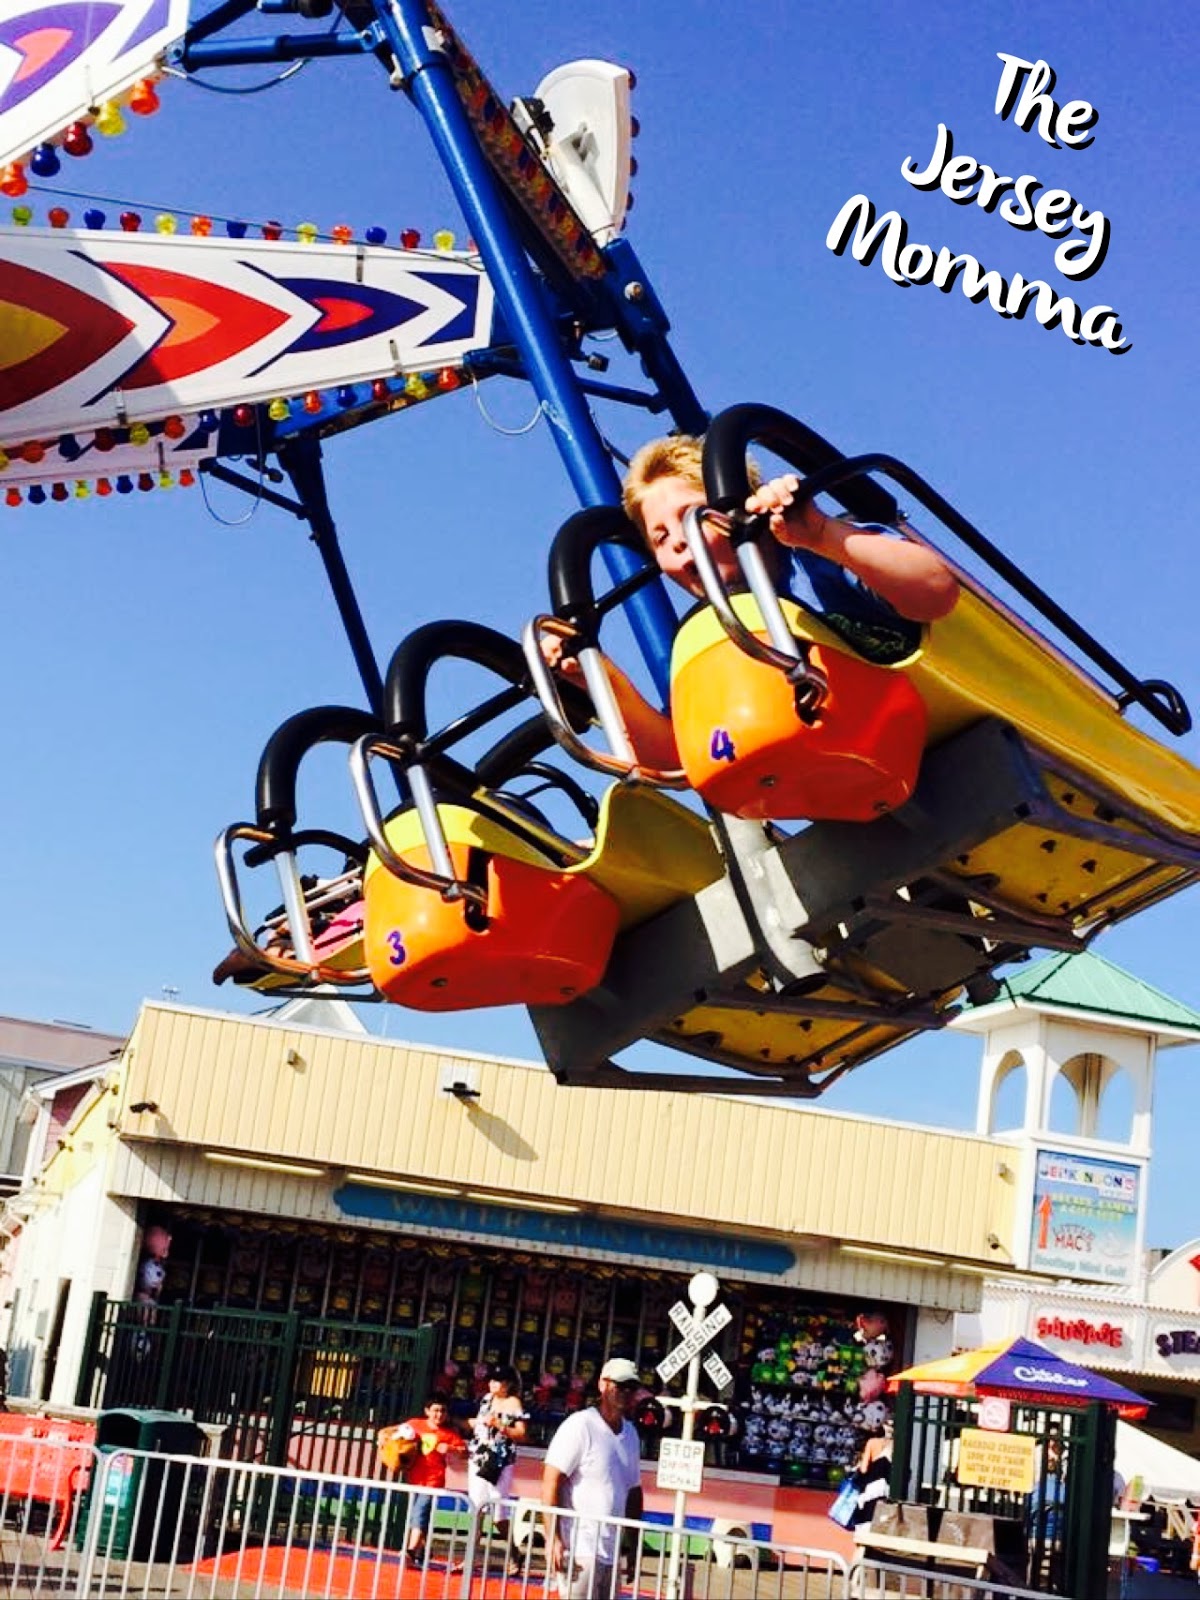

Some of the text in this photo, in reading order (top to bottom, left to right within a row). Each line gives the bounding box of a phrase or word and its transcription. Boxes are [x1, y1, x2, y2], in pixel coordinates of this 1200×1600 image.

[711, 729, 735, 764] 4
[387, 931, 405, 965] 3
[660, 1310, 726, 1378] CROSSING
[662, 1443, 702, 1459] STOP
